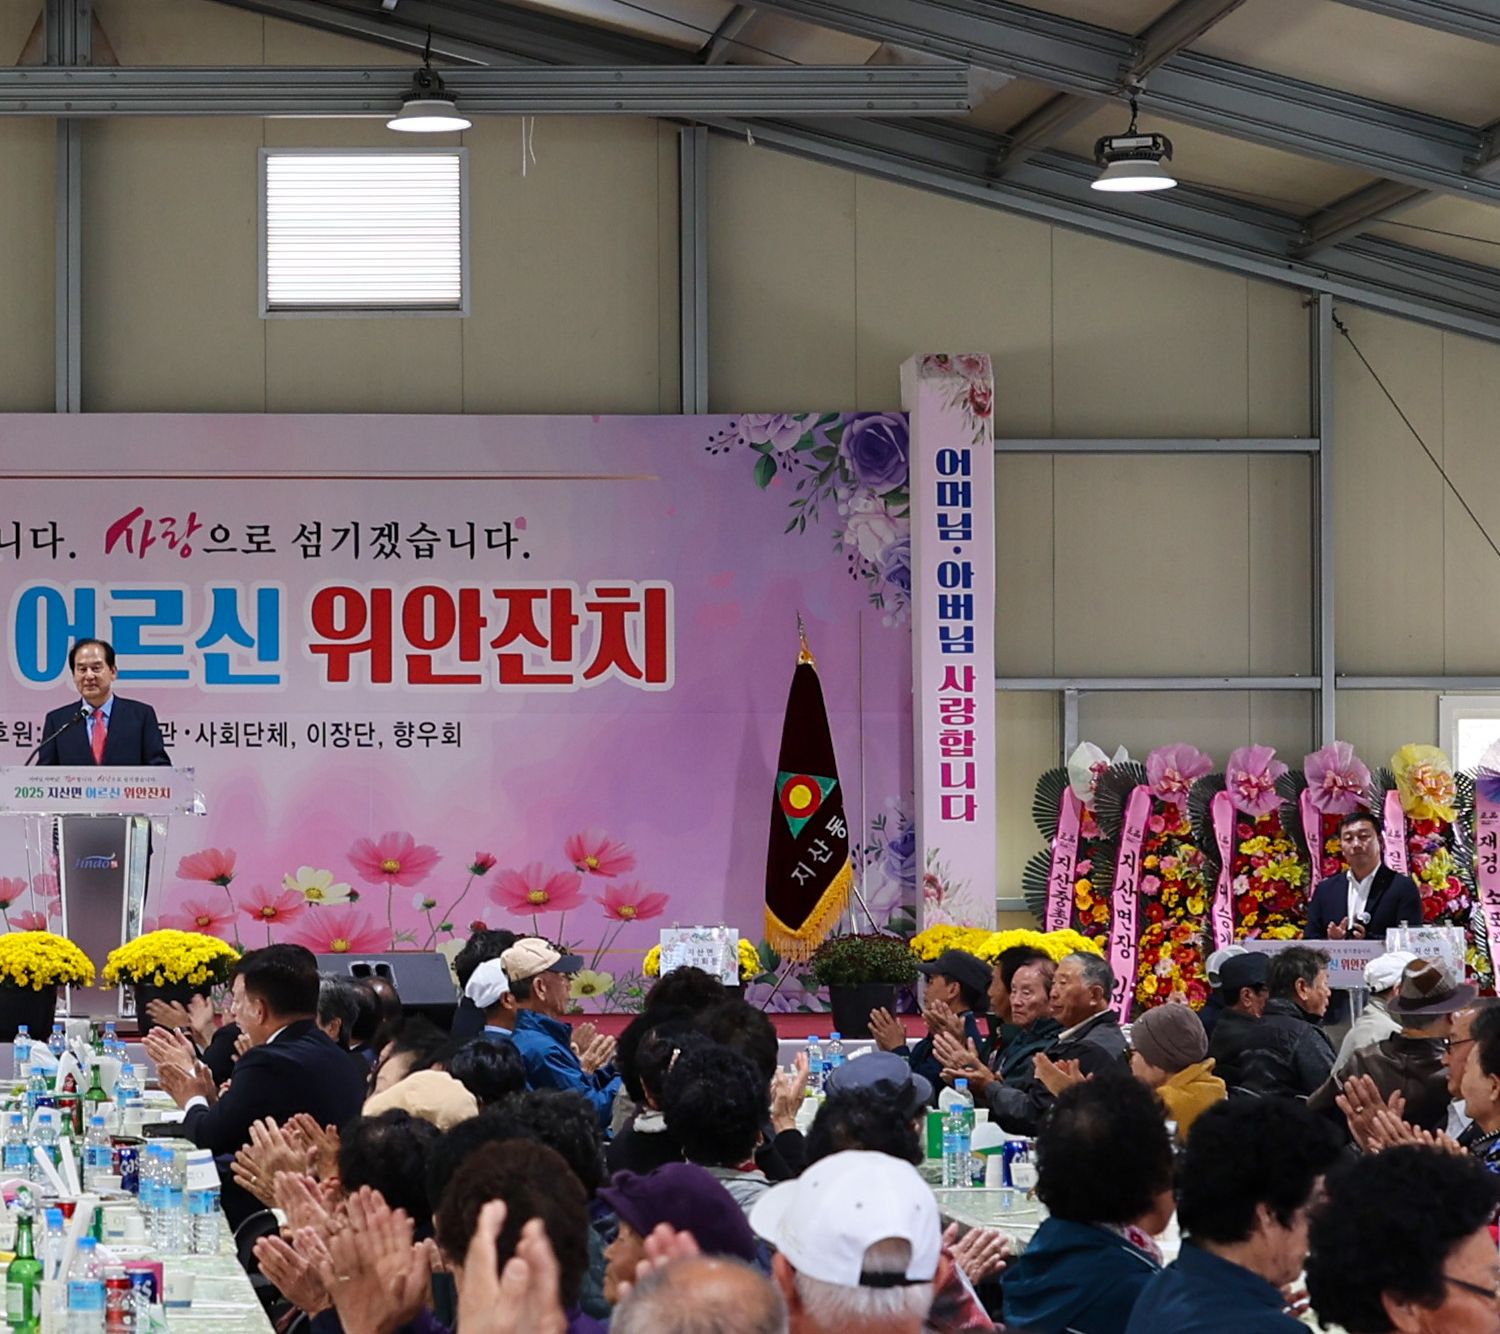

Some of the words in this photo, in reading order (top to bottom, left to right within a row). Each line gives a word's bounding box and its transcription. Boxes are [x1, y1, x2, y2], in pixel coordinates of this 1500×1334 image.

[104, 506, 277, 559] 사랑으로
[291, 521, 532, 560] 섬기겠습니다.
[14, 585, 281, 685] 어르신
[308, 584, 668, 685] 위안잔치
[158, 720, 296, 750] 관·사회단체,
[306, 720, 384, 750] 이장단,
[393, 720, 463, 749] 향우회
[937, 664, 979, 823] 사랑합니다
[14, 786, 44, 799] 2025
[47, 786, 82, 799] 지산면
[85, 786, 120, 799] 어르신
[124, 786, 171, 799] 위안잔치
[790, 814, 847, 887] 지산동
[1478, 831, 1498, 875] 재경
[1114, 851, 1139, 960] 지산면장
